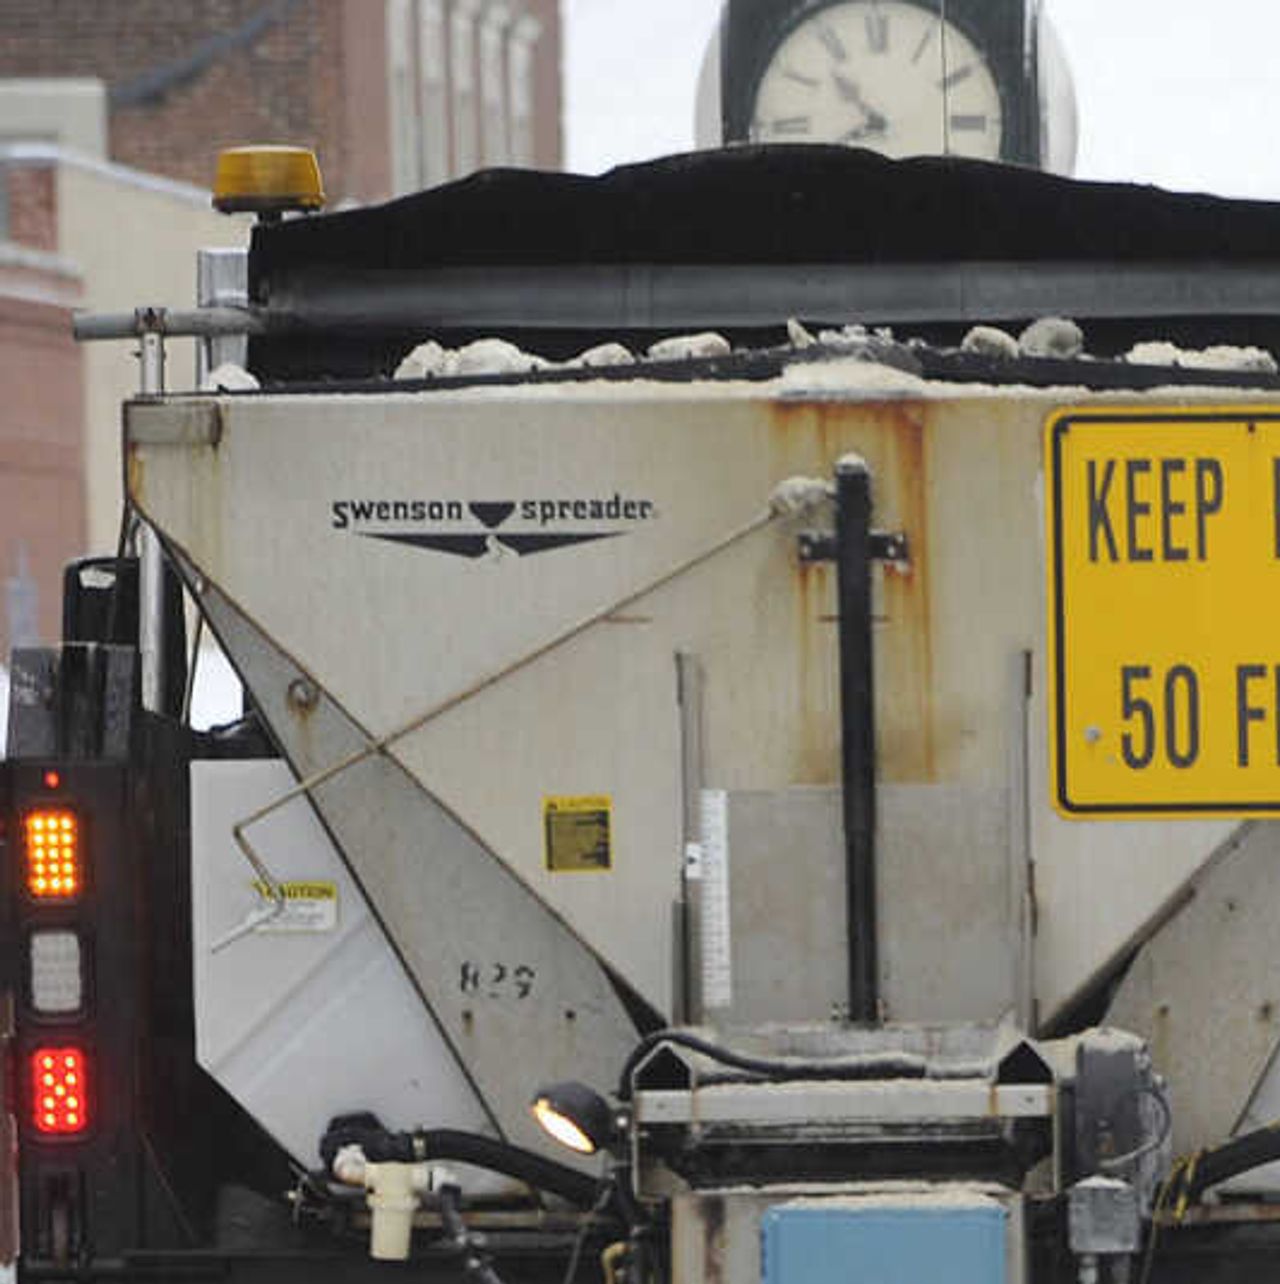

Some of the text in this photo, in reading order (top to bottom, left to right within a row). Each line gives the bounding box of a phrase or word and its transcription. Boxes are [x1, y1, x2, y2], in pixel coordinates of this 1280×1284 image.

[521, 493, 653, 525] spreader
[1086, 458, 1225, 562] KEEP
[1121, 664, 1199, 770] 50
